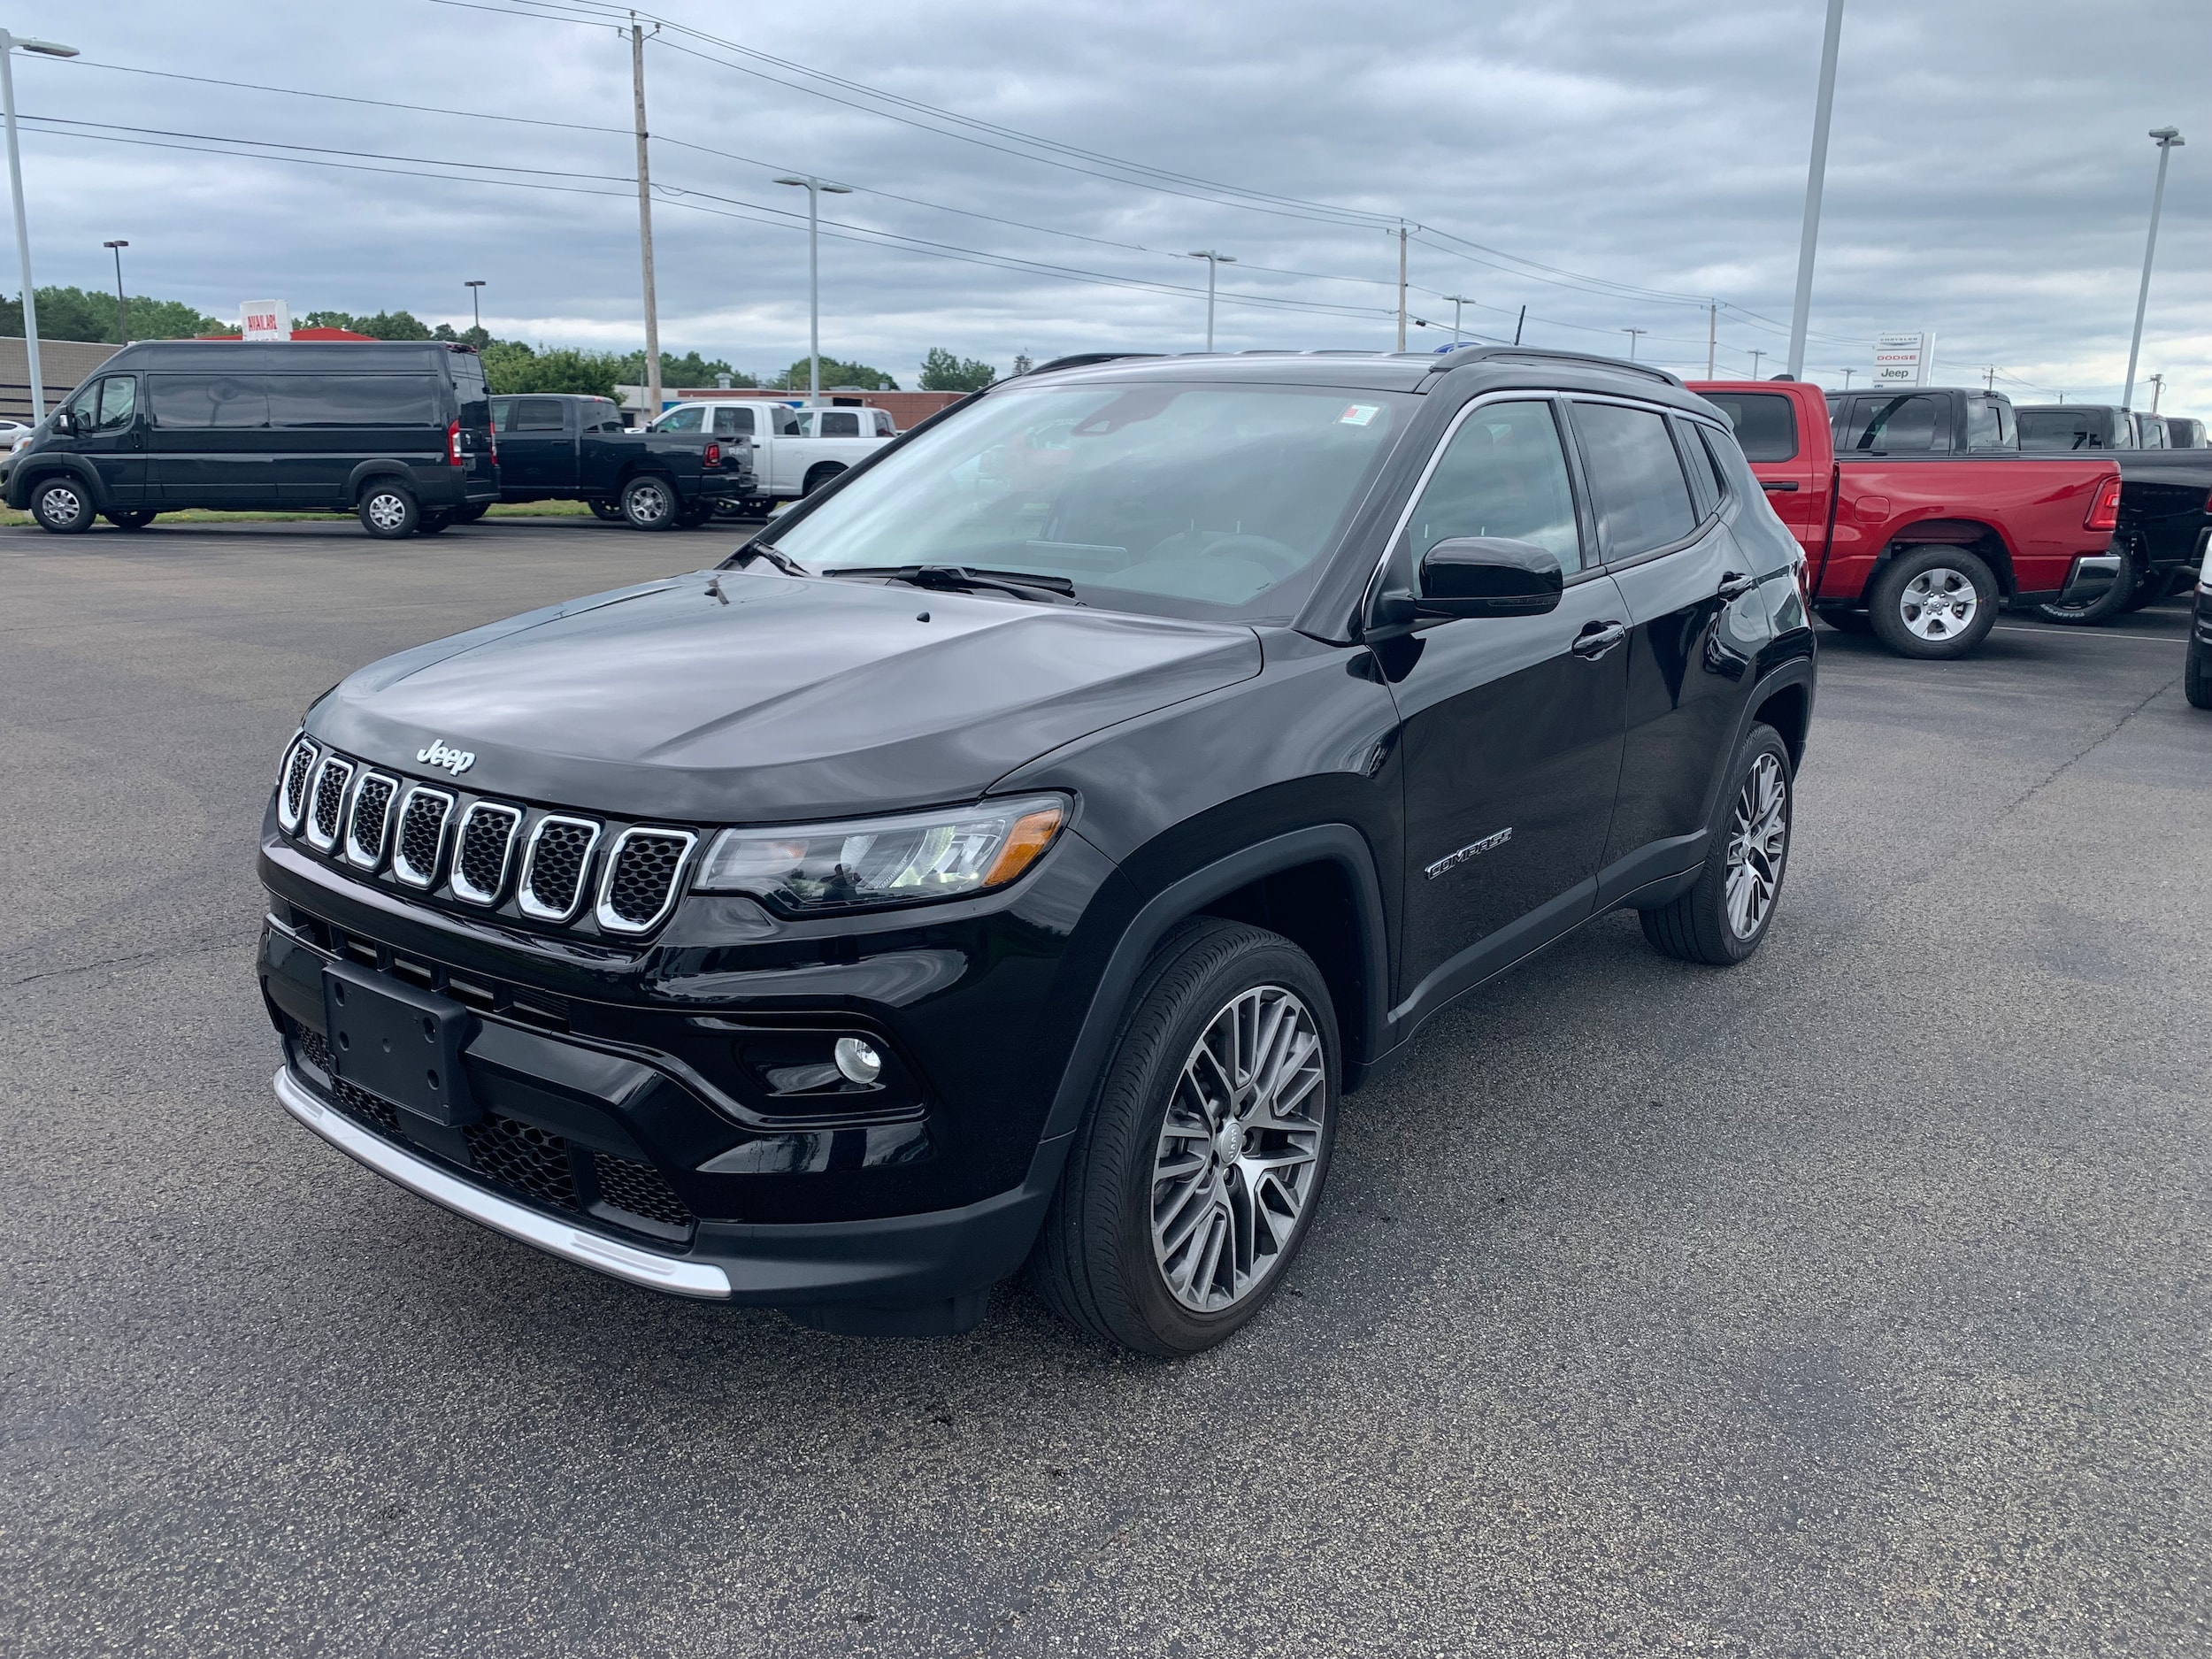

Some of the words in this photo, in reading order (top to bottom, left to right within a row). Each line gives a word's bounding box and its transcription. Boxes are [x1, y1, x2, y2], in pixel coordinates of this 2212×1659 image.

[1881, 368, 1909, 379] Jeep
[416, 738, 476, 777] Jeep
[1424, 826, 1513, 880] COMPASS
[1227, 1128, 1238, 1159] Jeep
